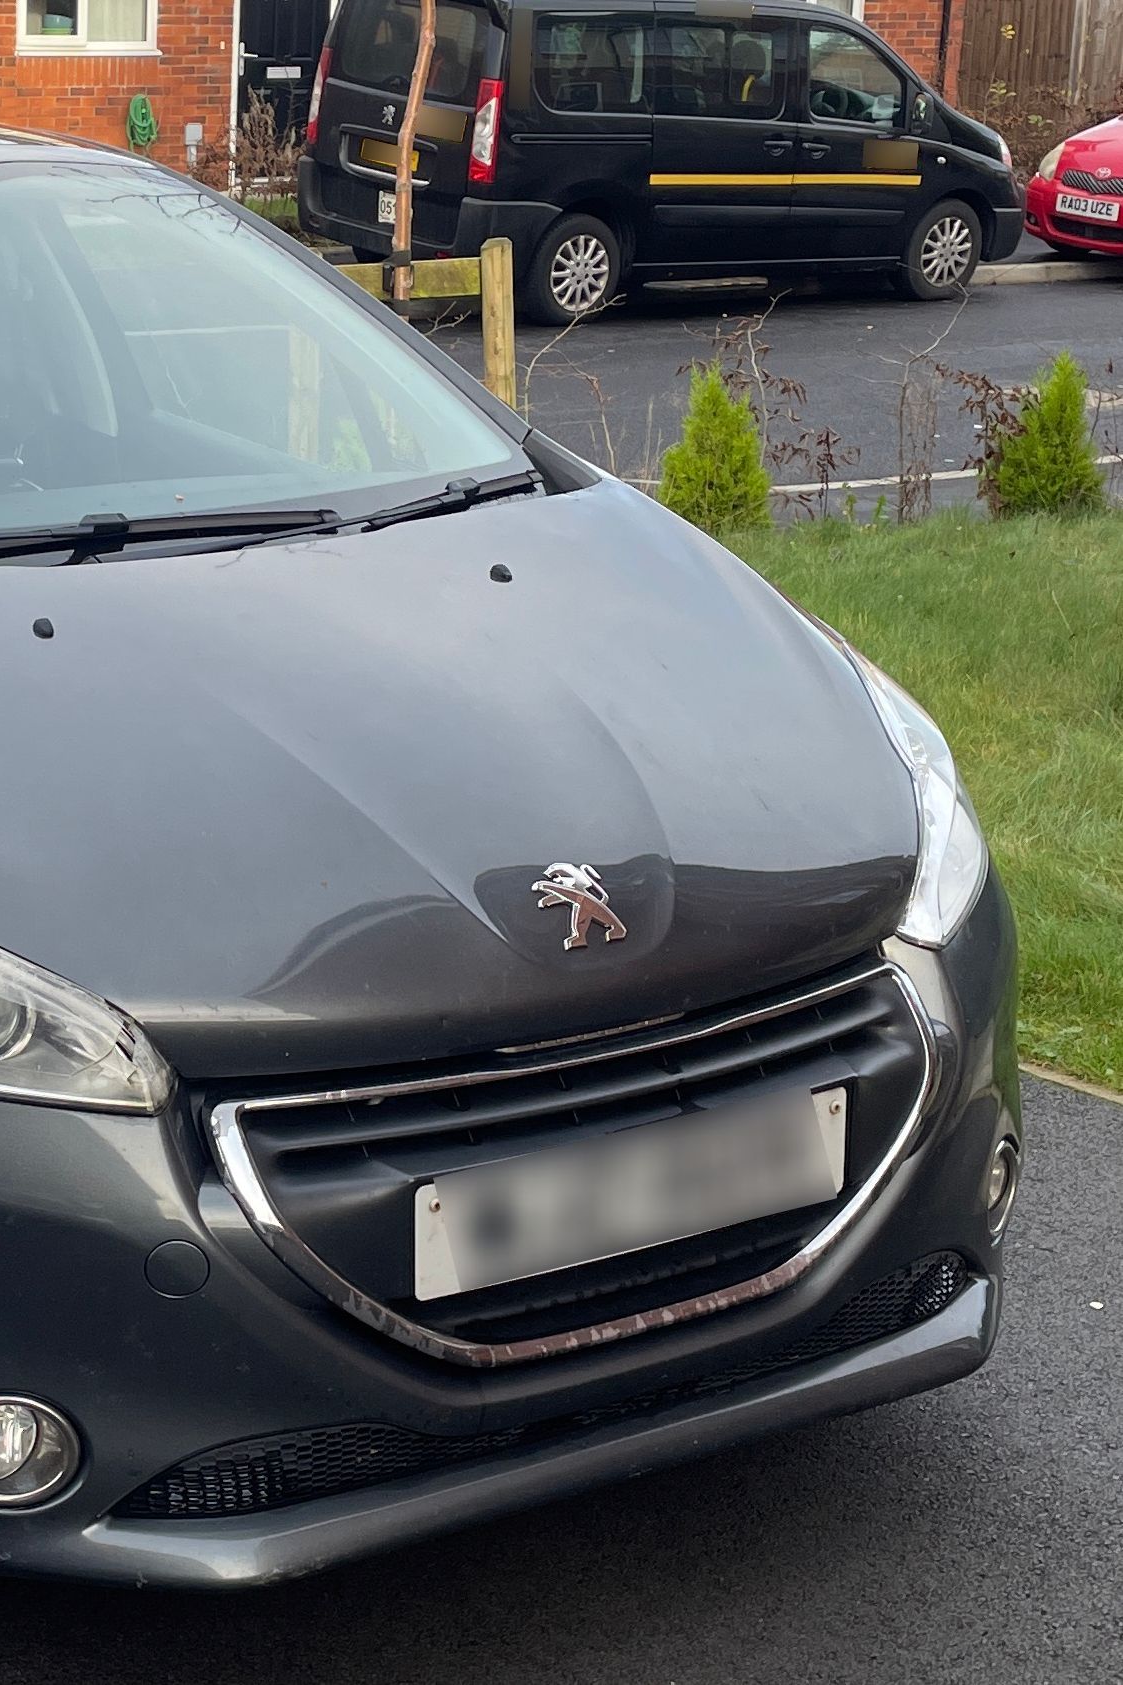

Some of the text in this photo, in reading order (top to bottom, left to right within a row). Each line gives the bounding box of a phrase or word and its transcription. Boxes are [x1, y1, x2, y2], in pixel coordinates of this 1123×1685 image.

[380, 200, 396, 214] 05
[1061, 195, 1114, 216] RA03 UZE
